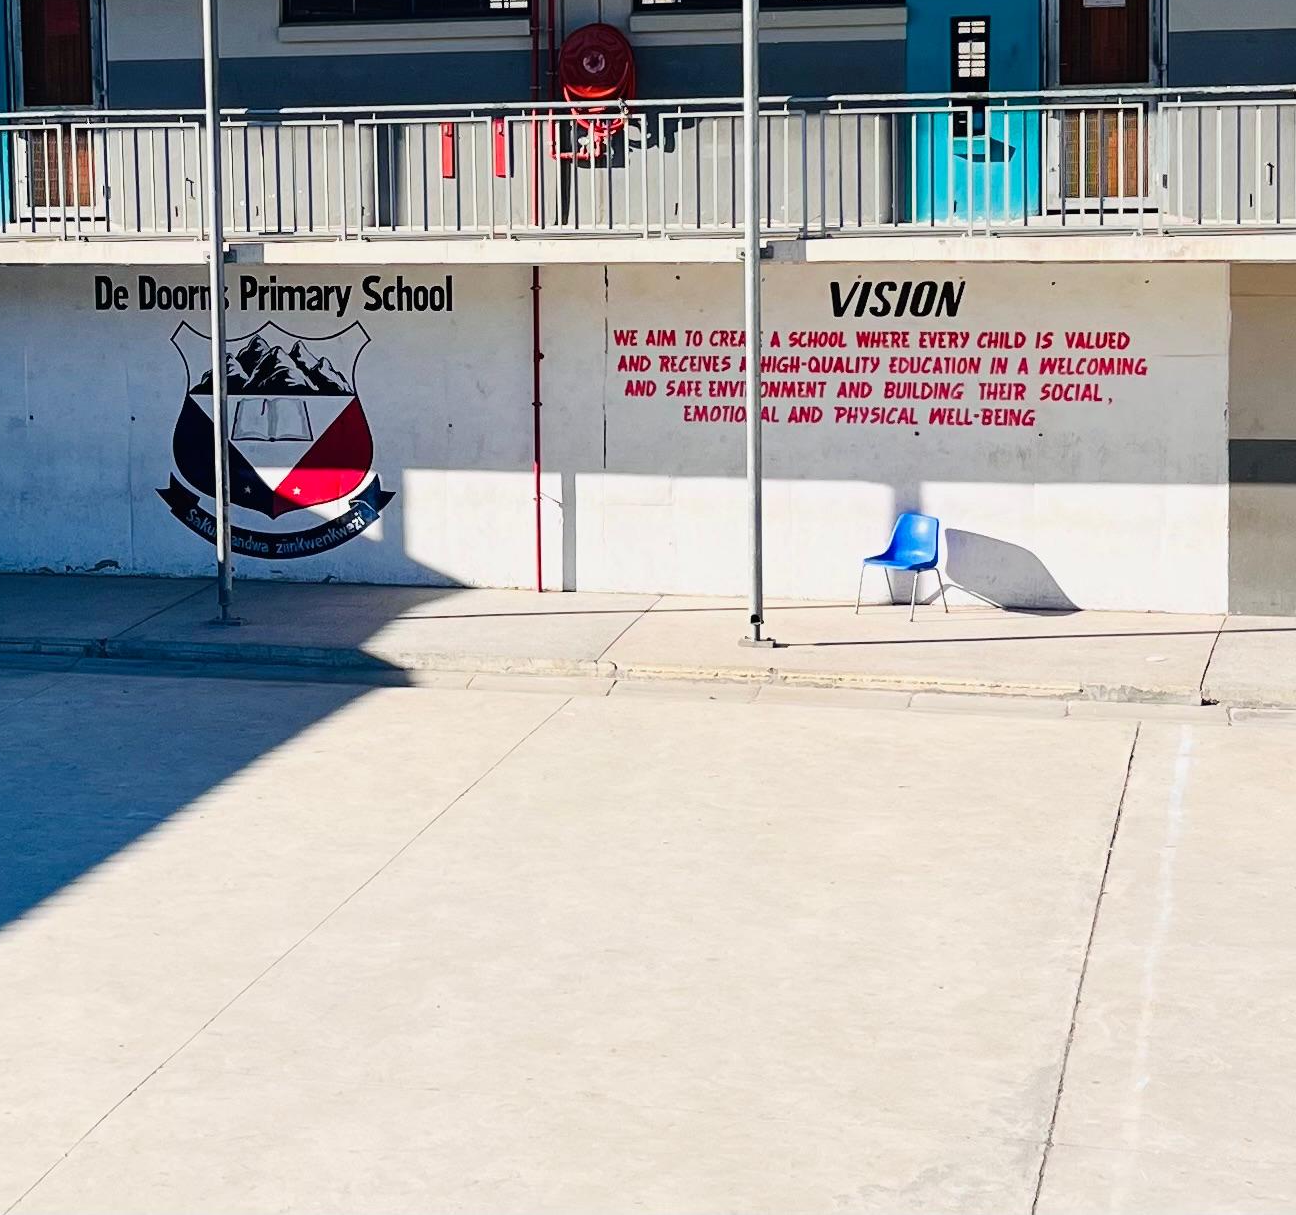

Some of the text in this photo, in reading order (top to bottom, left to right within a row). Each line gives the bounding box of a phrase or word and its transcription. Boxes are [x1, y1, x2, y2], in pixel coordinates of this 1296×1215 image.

[94, 276, 129, 310] De
[240, 275, 353, 317] Primary
[363, 275, 453, 311] School
[830, 281, 966, 317] VISION
[614, 329, 1130, 350] WE AIM TO CREA A SCHOOL WHERE EVERY CHILD IS VALUED
[617, 355, 651, 373] AND
[659, 355, 731, 373] RECEIVES
[760, 356, 880, 374] HIGH-QUALITY
[889, 357, 981, 374] EDUCATION
[990, 357, 1008, 374] IN
[1017, 357, 1029, 375] A
[1039, 357, 1148, 376] WELCOMING
[625, 380, 657, 397] AND
[666, 380, 702, 397] SAFE
[709, 381, 827, 398] ENVIONMENT
[837, 381, 872, 399] AND
[884, 381, 964, 400] BUILDING
[979, 383, 1026, 401] THEIR
[684, 405, 1036, 426] EMOTIOAL AND PHYSICAL WELL-BEING
